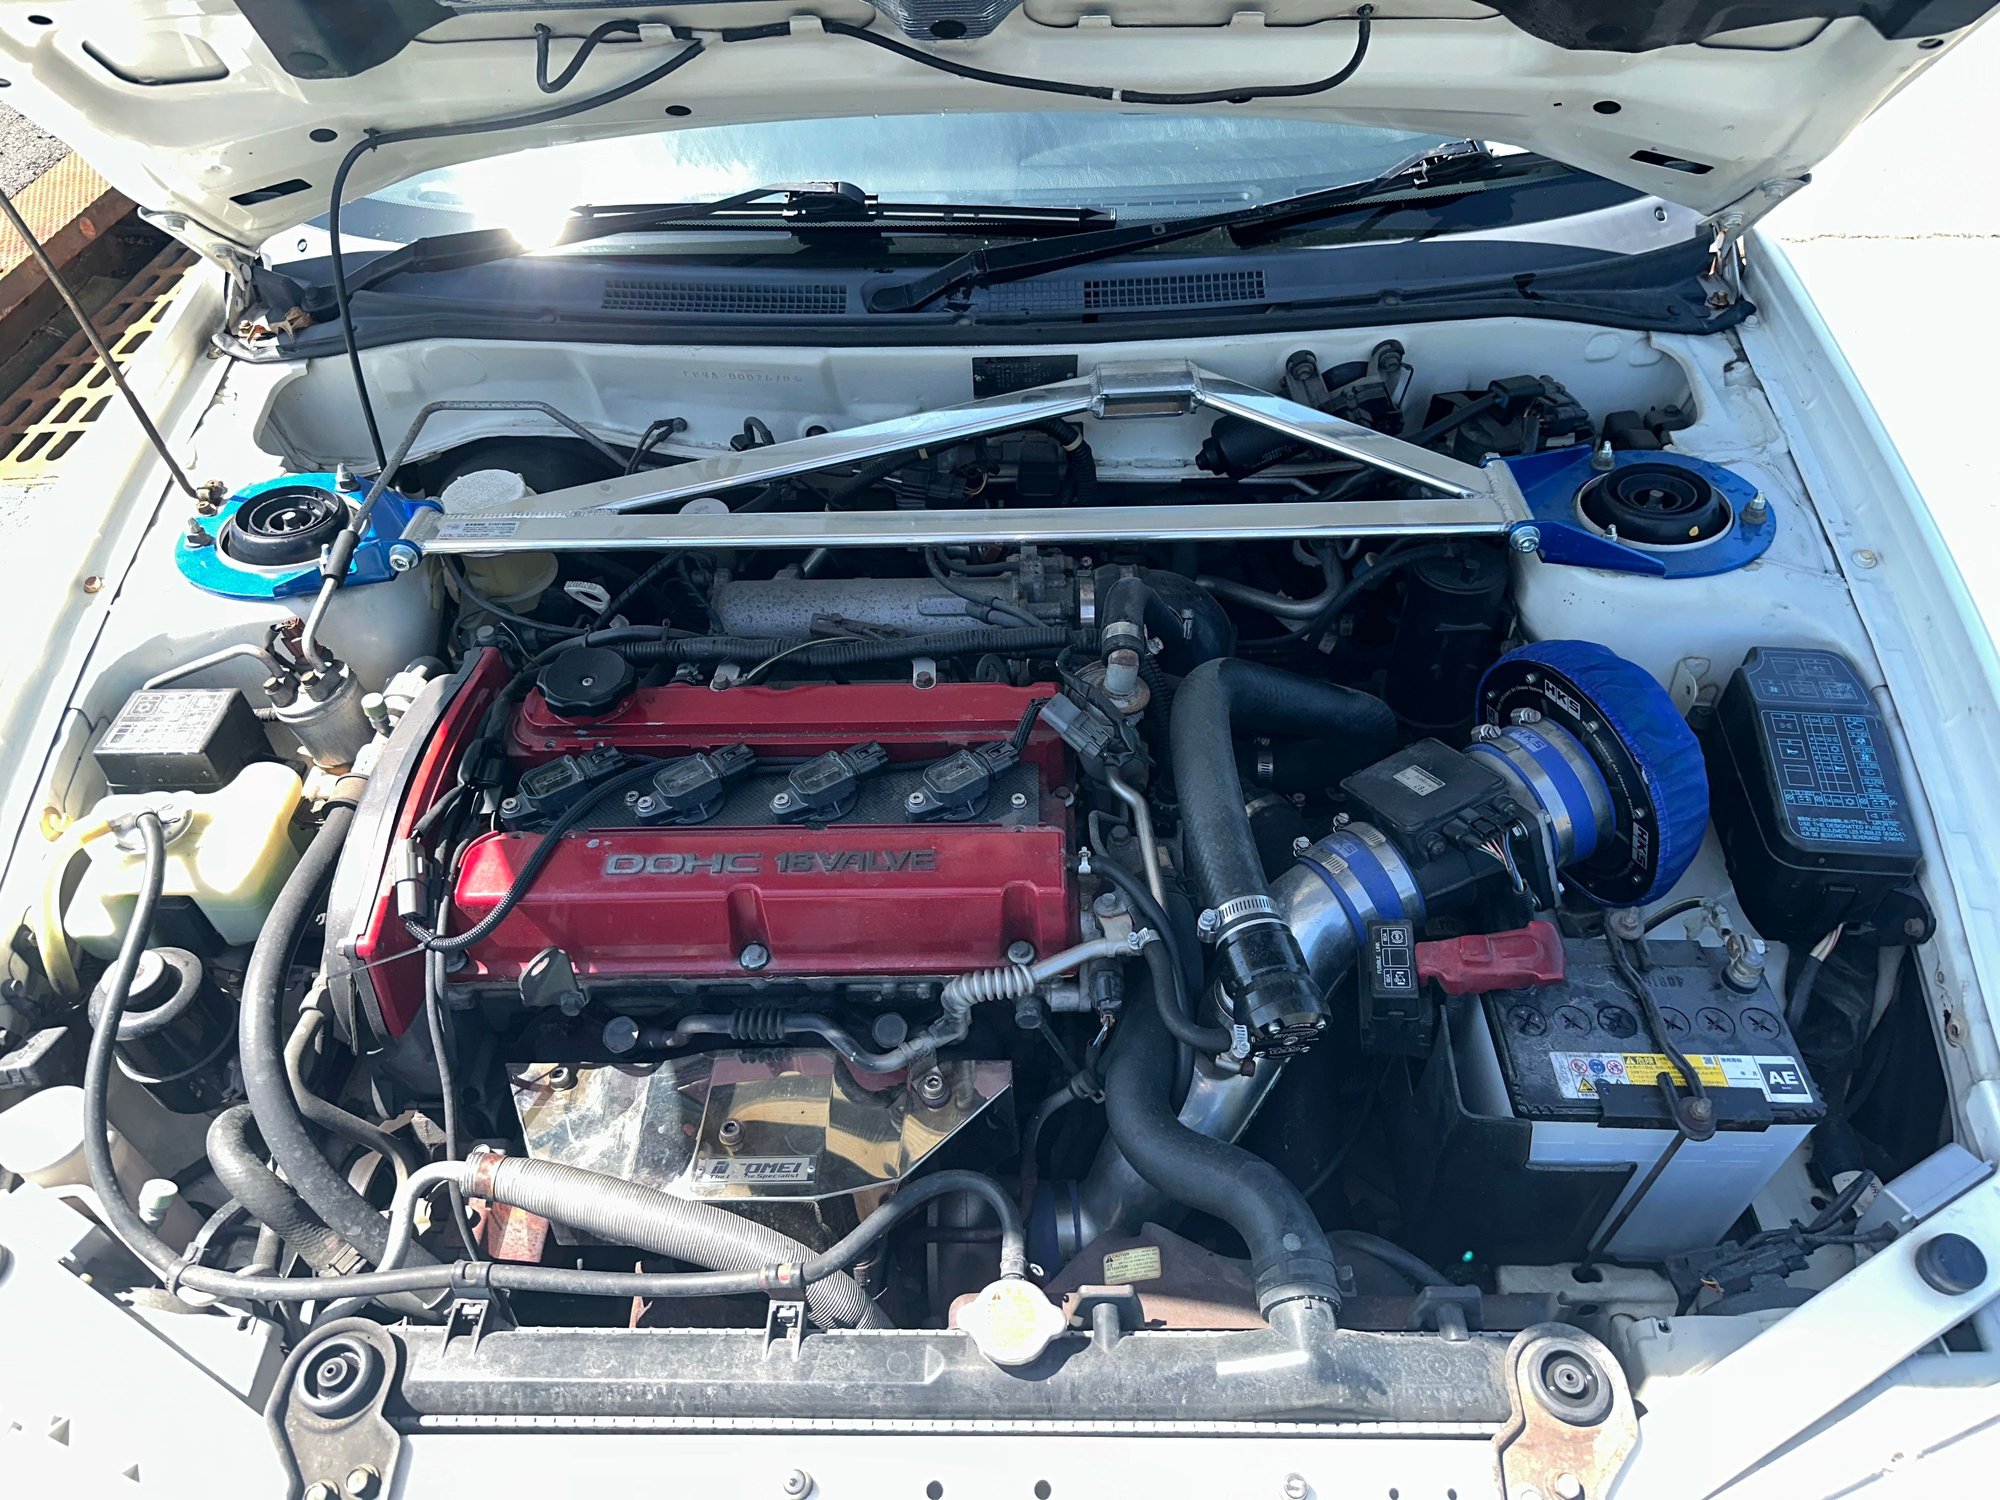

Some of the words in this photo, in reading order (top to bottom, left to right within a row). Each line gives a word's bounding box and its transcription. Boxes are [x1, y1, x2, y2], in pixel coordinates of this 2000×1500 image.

[1544, 679, 1581, 721] HKS
[1510, 729, 1547, 752] HKS
[1631, 821, 1649, 870] HKS
[604, 851, 762, 876] DOHC
[1769, 1071, 1799, 1085] AE
